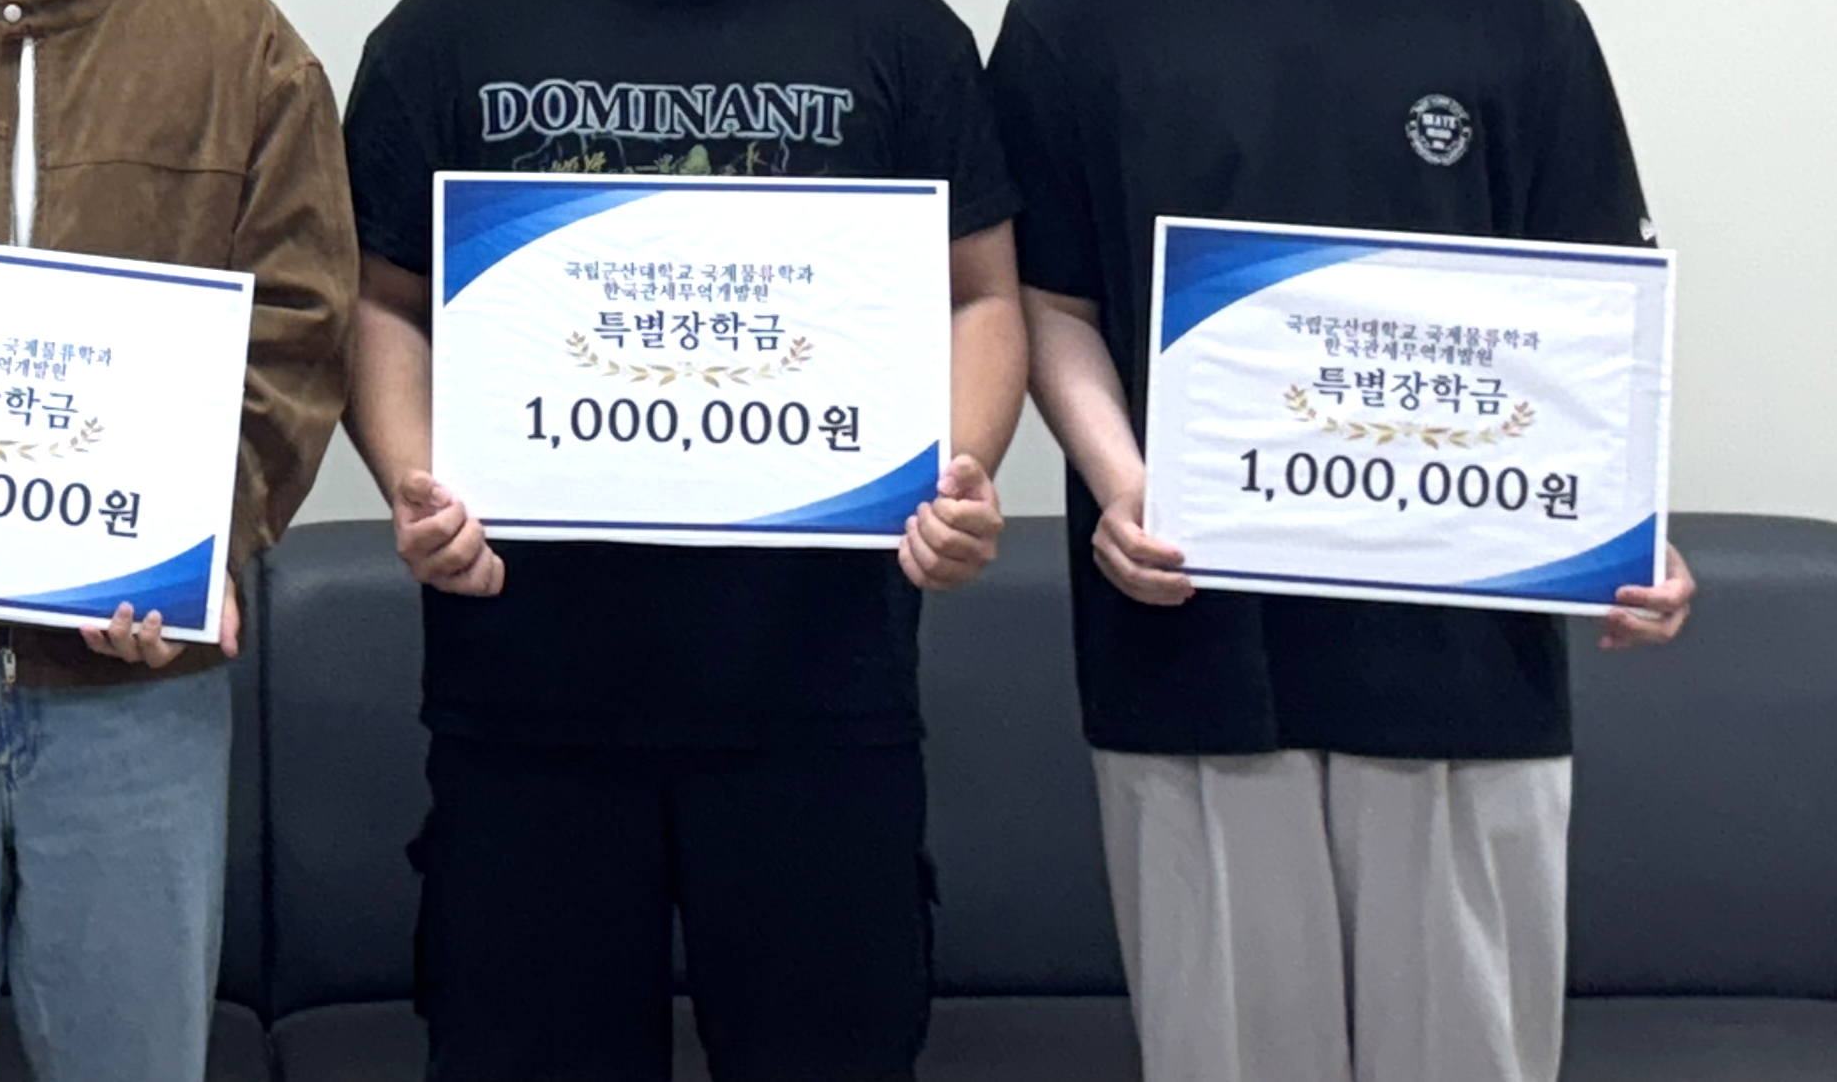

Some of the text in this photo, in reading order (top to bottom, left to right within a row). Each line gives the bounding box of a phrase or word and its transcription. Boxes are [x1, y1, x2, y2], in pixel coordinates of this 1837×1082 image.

[479, 79, 854, 146] DOMINANT
[564, 261, 814, 284] 국립군산대학교 국제물류학과
[603, 282, 769, 303] 한국관세무역개발원
[593, 310, 786, 351] 특별장학금
[1286, 314, 1541, 350] 국립군산대학교 국제물류학과
[3, 337, 112, 367] 국제물류학과
[1325, 336, 1493, 367] 한국관세무역개발원
[1313, 366, 1508, 415] 특별장학금
[525, 397, 861, 452] 1,000,000원
[1240, 448, 1579, 520] 1,000,000원
